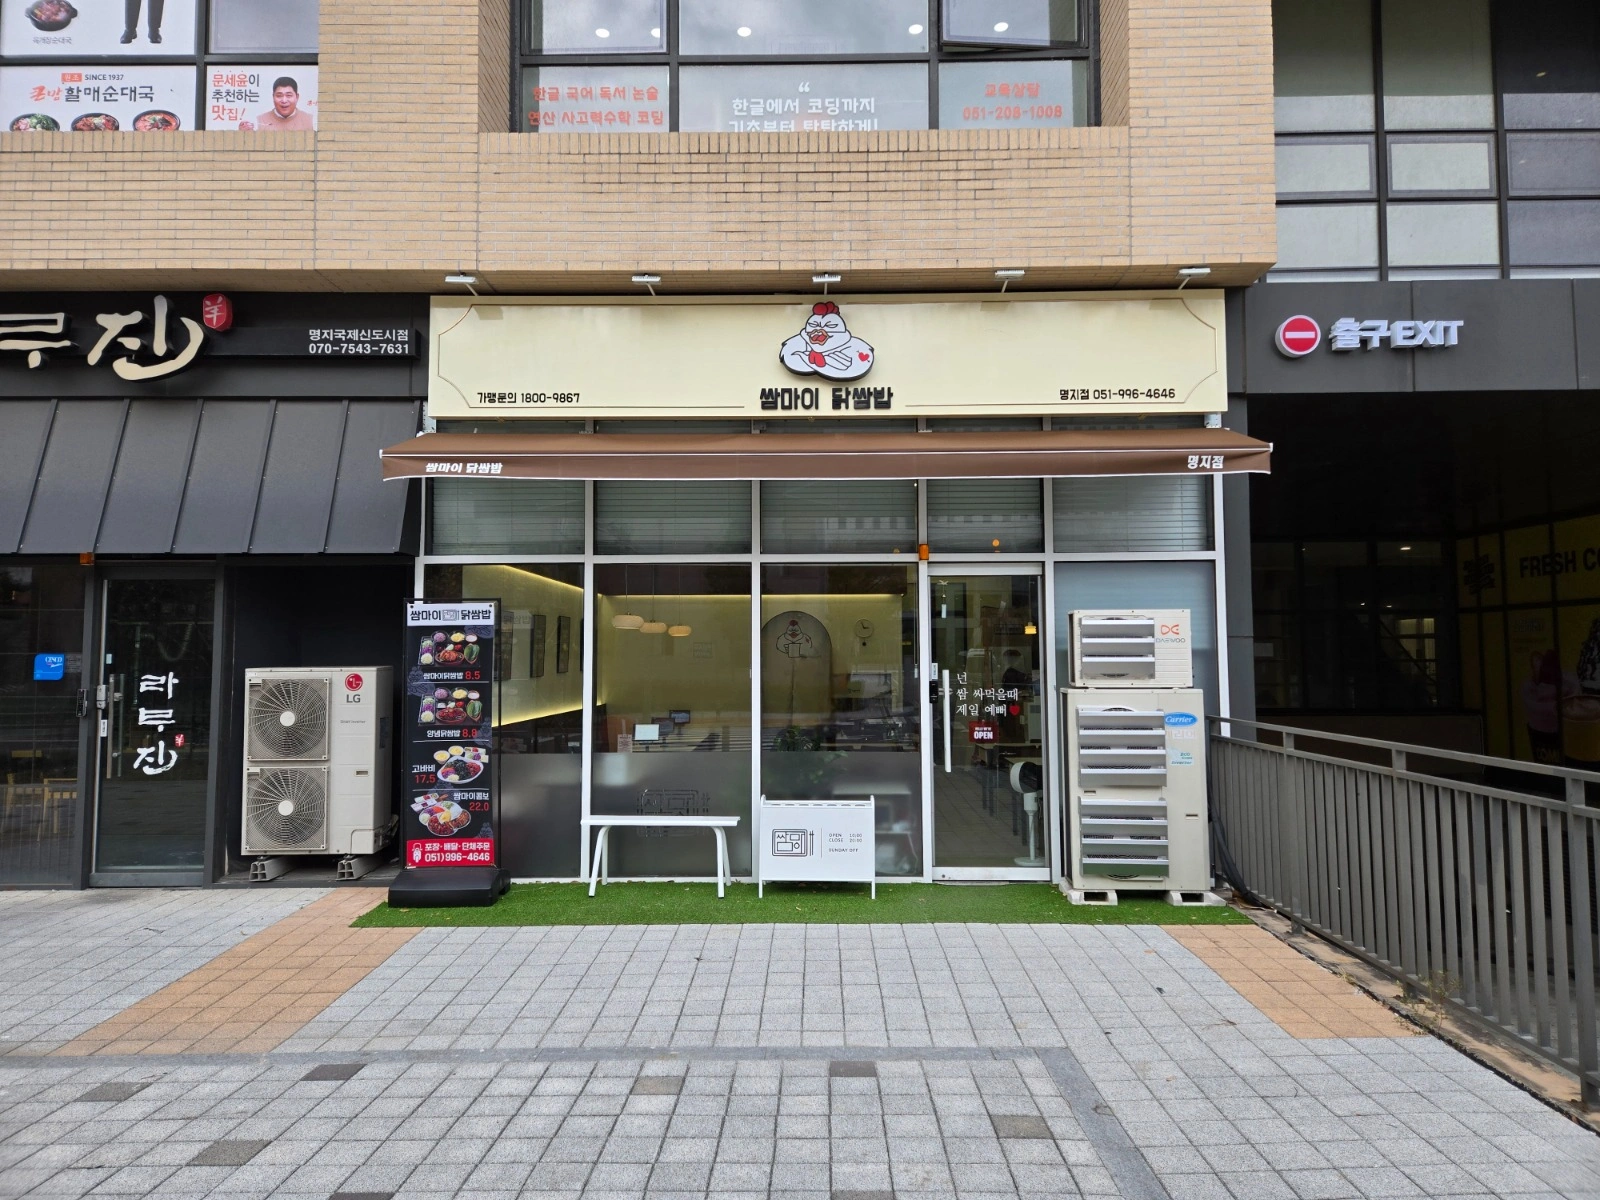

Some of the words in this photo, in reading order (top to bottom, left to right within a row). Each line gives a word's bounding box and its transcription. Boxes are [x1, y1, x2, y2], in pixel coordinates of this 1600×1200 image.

[212, 74, 260, 87] 문세윤이
[212, 89, 260, 103] 추천하는
[532, 86, 560, 102] 한글
[566, 86, 594, 102] 국어
[599, 86, 627, 102] 독서
[633, 86, 659, 101] 논술
[212, 105, 246, 121] 맛집!
[732, 98, 800, 116] 한글에서
[807, 98, 875, 116] 코딩까지
[528, 111, 556, 126] 연산
[637, 110, 664, 126] 코딩
[308, 328, 409, 341] 명지국제신도시점
[1329, 317, 1391, 351] 출구
[1391, 320, 1465, 349] EXIT
[308, 343, 409, 354] 070-7543-7631
[477, 392, 517, 404] 가맹문의
[520, 392, 580, 404] 1800-9867
[759, 387, 820, 410] 쌈마이
[831, 386, 894, 410] 닭쌈밥
[1059, 388, 1090, 401] 명지점
[1093, 388, 1176, 400] 051-996-4646
[425, 462, 463, 473] 쌈마이
[466, 462, 504, 475] 닭쌈밥
[1187, 455, 1225, 470] 명지점
[1519, 550, 1577, 579] FRESH
[1582, 548, 1600, 572] C
[410, 609, 442, 621] 쌈마이
[461, 609, 492, 621] 닭쌈밥
[465, 670, 481, 680] 8.5
[346, 694, 361, 704] LG
[972, 687, 1019, 701] 싸먹을때
[956, 703, 979, 717] 제일
[984, 703, 1007, 717] 예뻐
[1165, 715, 1194, 723] Carrier
[973, 731, 993, 740] OPEN
[415, 774, 436, 783] 17.5
[469, 802, 490, 811] 22.0
[424, 852, 490, 863] 051)996-4646
